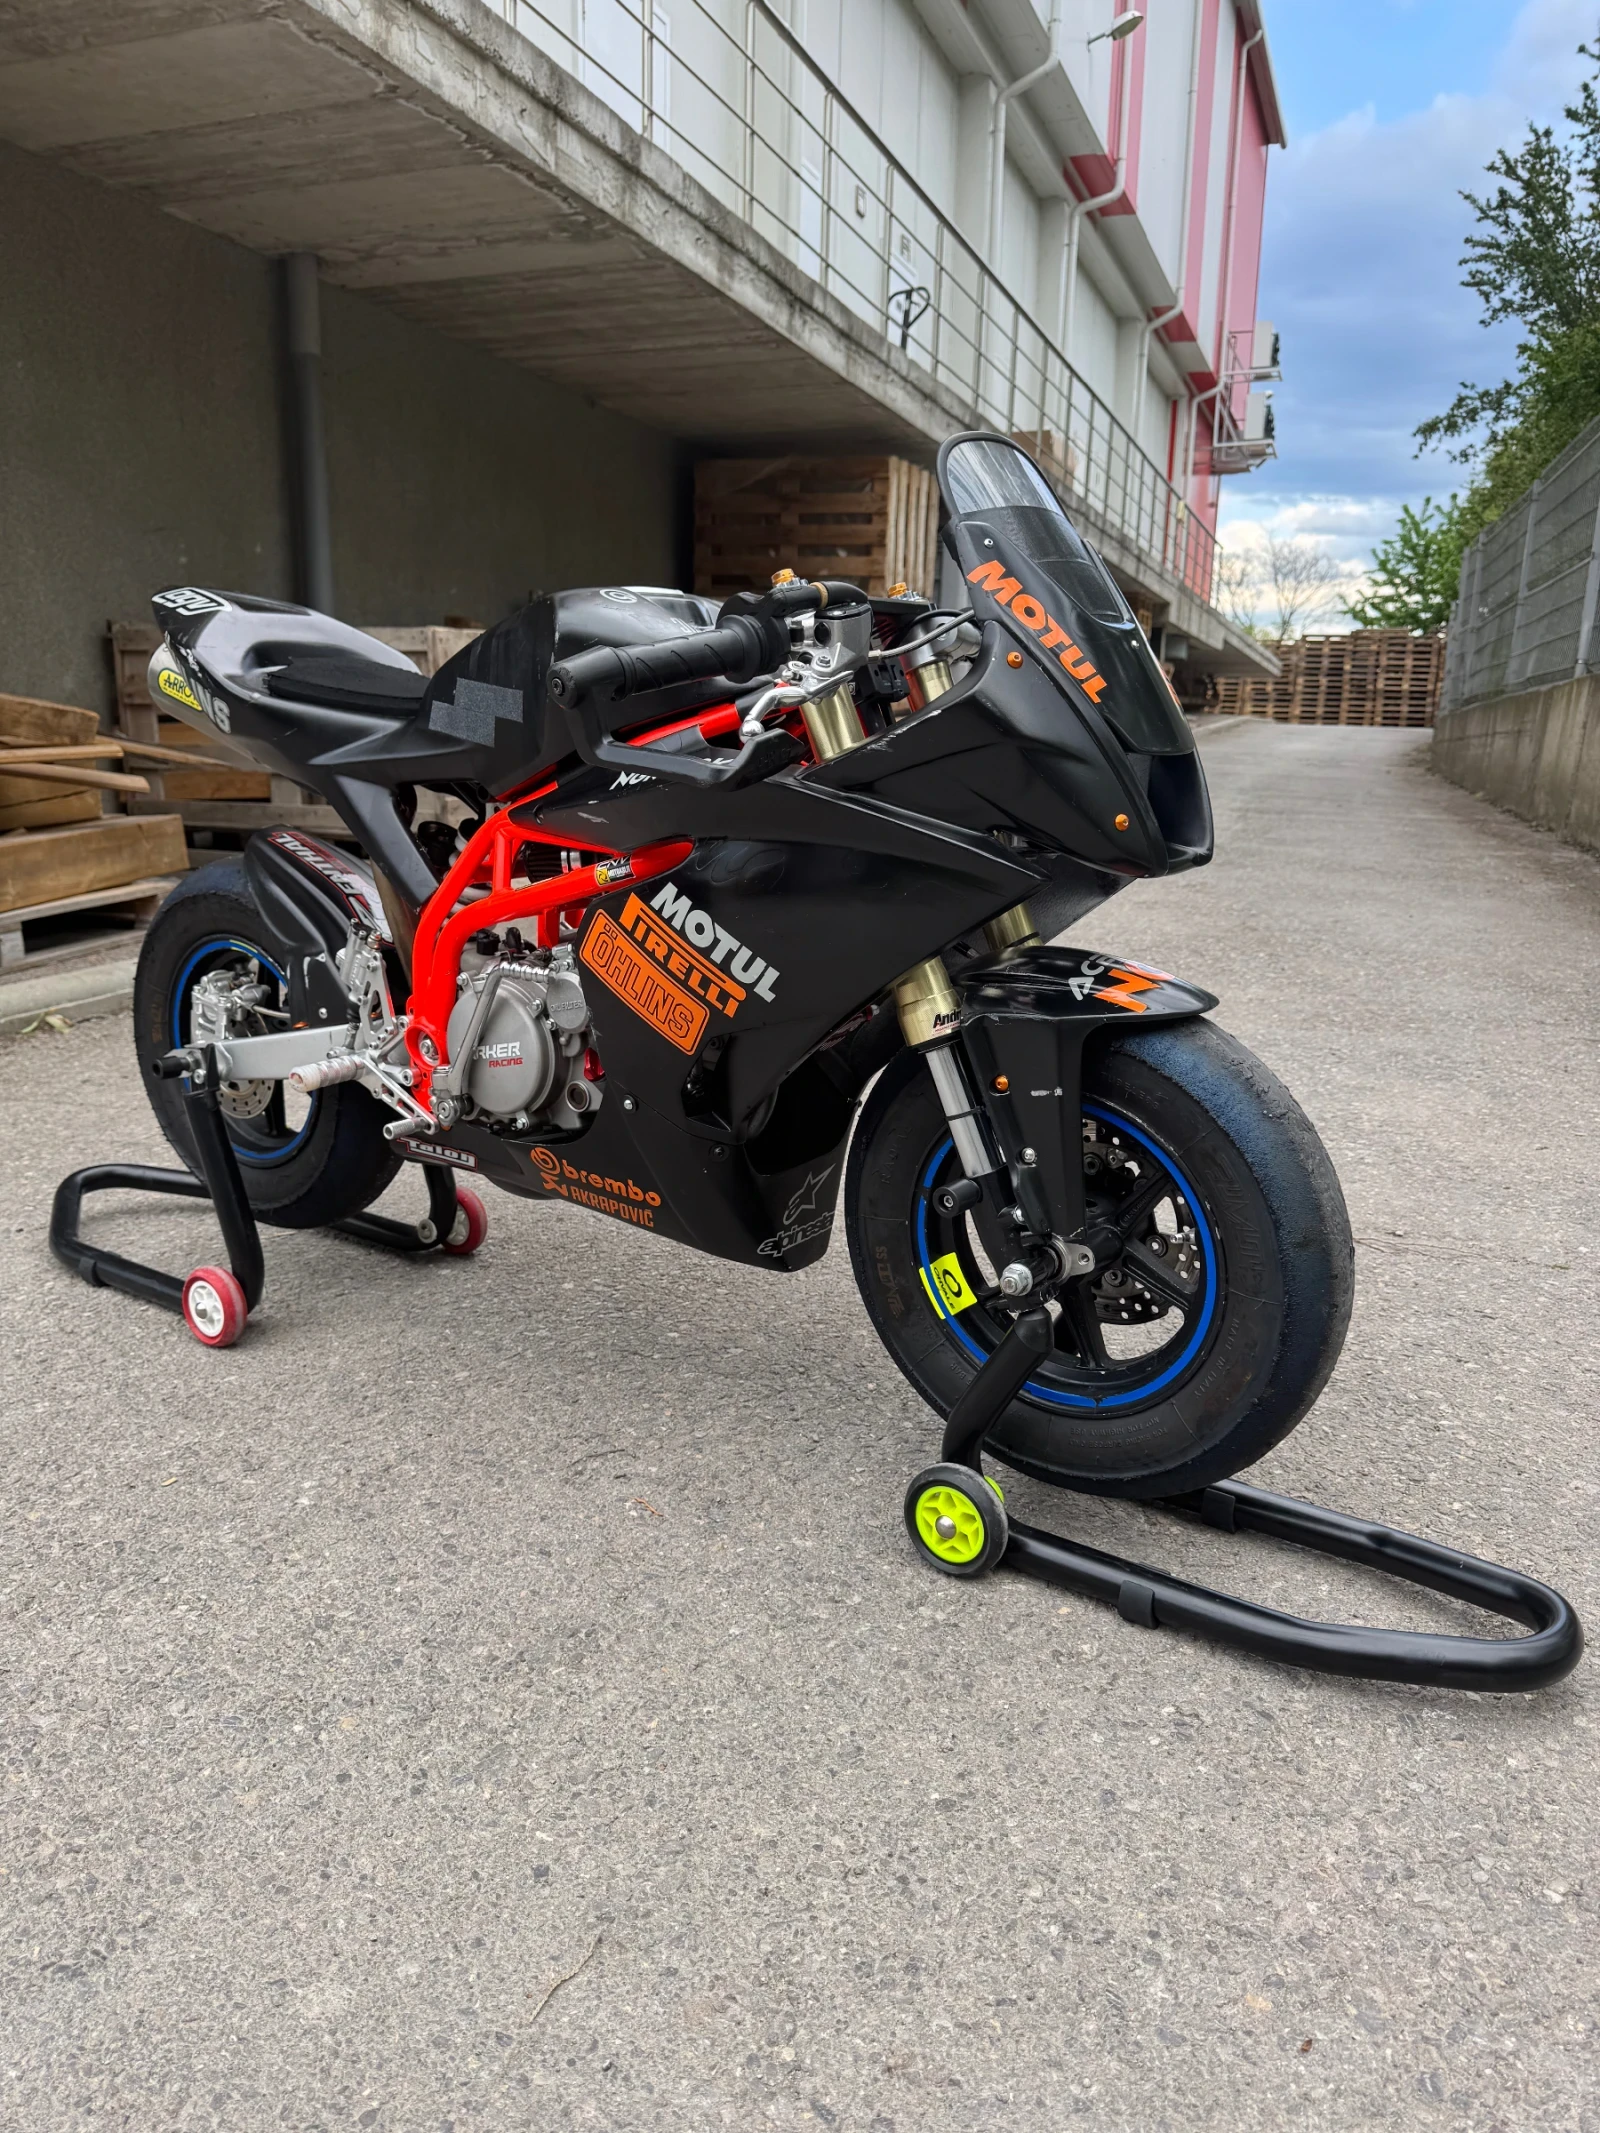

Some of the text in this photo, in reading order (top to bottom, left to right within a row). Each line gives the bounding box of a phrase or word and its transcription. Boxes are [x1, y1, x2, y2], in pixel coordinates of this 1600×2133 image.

[162, 674, 197, 701] ARRO
[967, 559, 1108, 704] MOTUL
[591, 922, 695, 1039] ÖHLINS
[618, 891, 747, 1018] PIRELLI
[650, 881, 781, 1003] MOTUL
[488, 1057, 523, 1068] RACING
[562, 1159, 661, 1207] brembo
